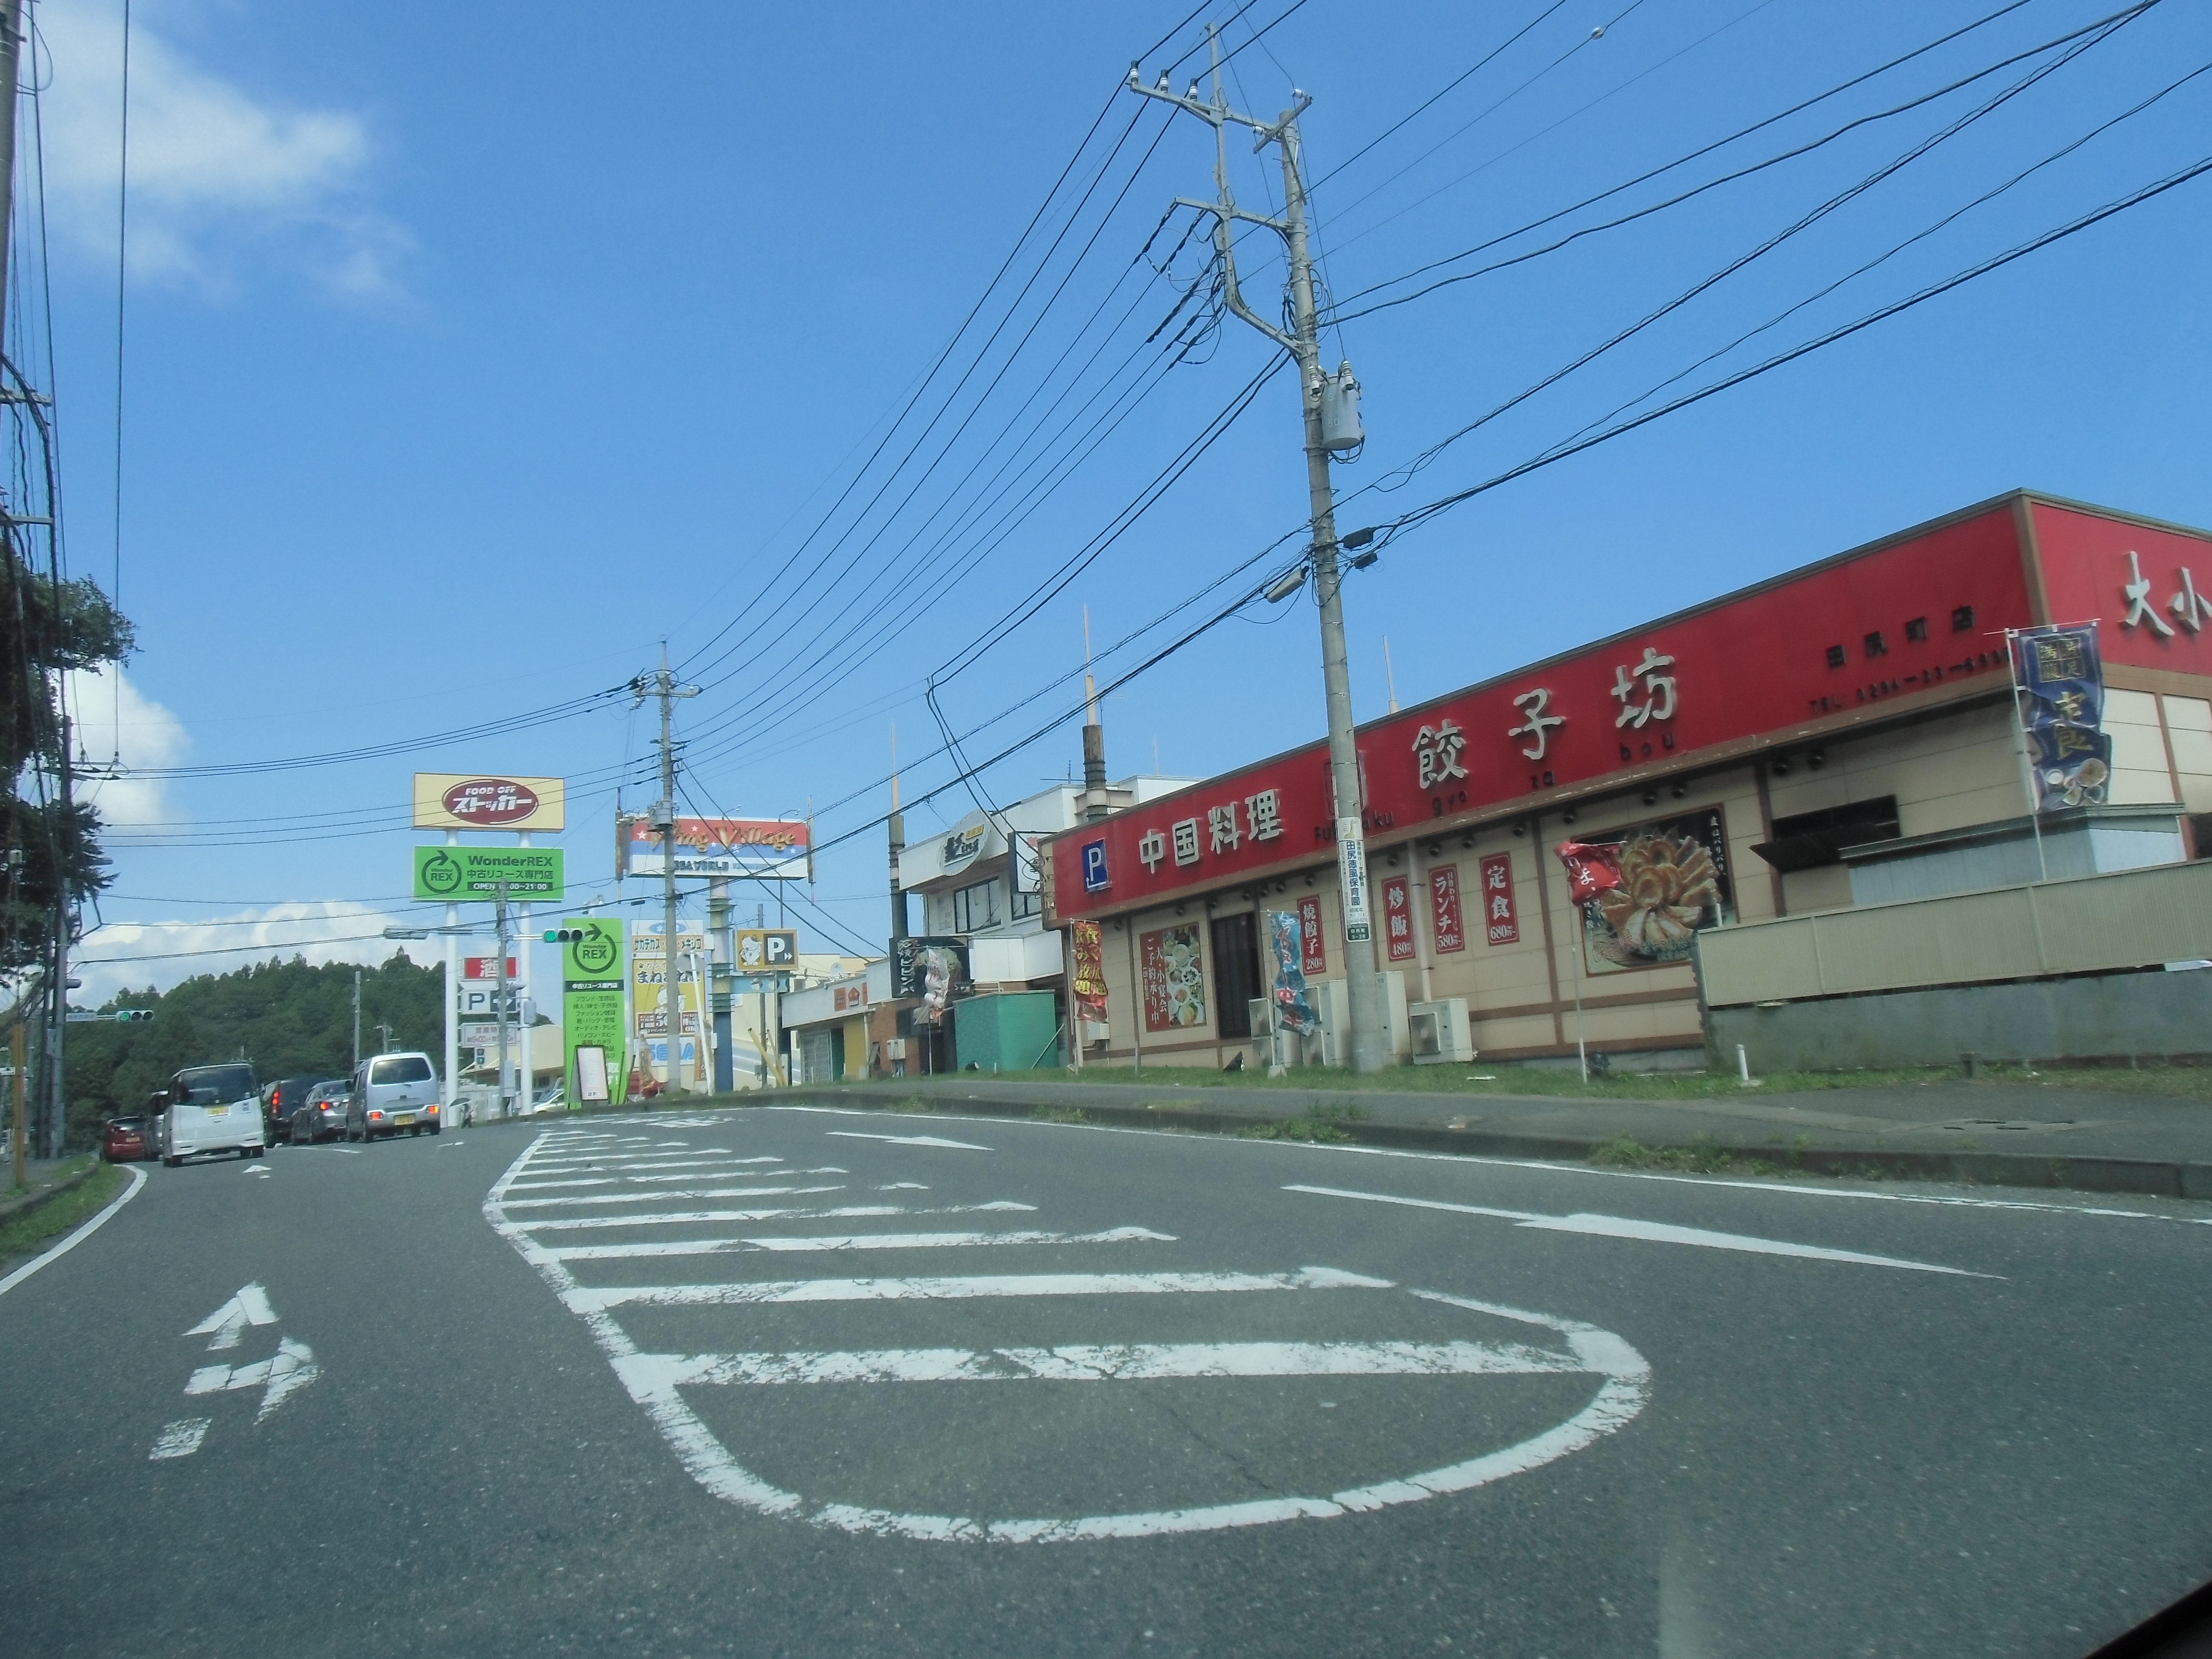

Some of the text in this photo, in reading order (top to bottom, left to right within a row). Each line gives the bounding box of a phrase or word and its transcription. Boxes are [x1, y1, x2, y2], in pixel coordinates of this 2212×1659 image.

[1412, 647, 1675, 789] 餃子坊
[465, 786, 517, 795] FOOD OFF
[452, 795, 532, 813] ストッカー
[715, 827, 796, 852] Village
[1139, 789, 1284, 875] 中国料理
[468, 855, 553, 867] WonderREX
[1088, 847, 1102, 881] P
[431, 873, 453, 881] REX
[467, 870, 553, 879] 中古リユース専門店
[1487, 865, 1510, 920] 定食
[1389, 886, 1407, 938] 炒飯
[1435, 876, 1452, 934] ランチ
[582, 949, 607, 959] REX
[768, 938, 786, 962] P
[469, 993, 485, 1010] P
[649, 1043, 696, 1061] SEA
